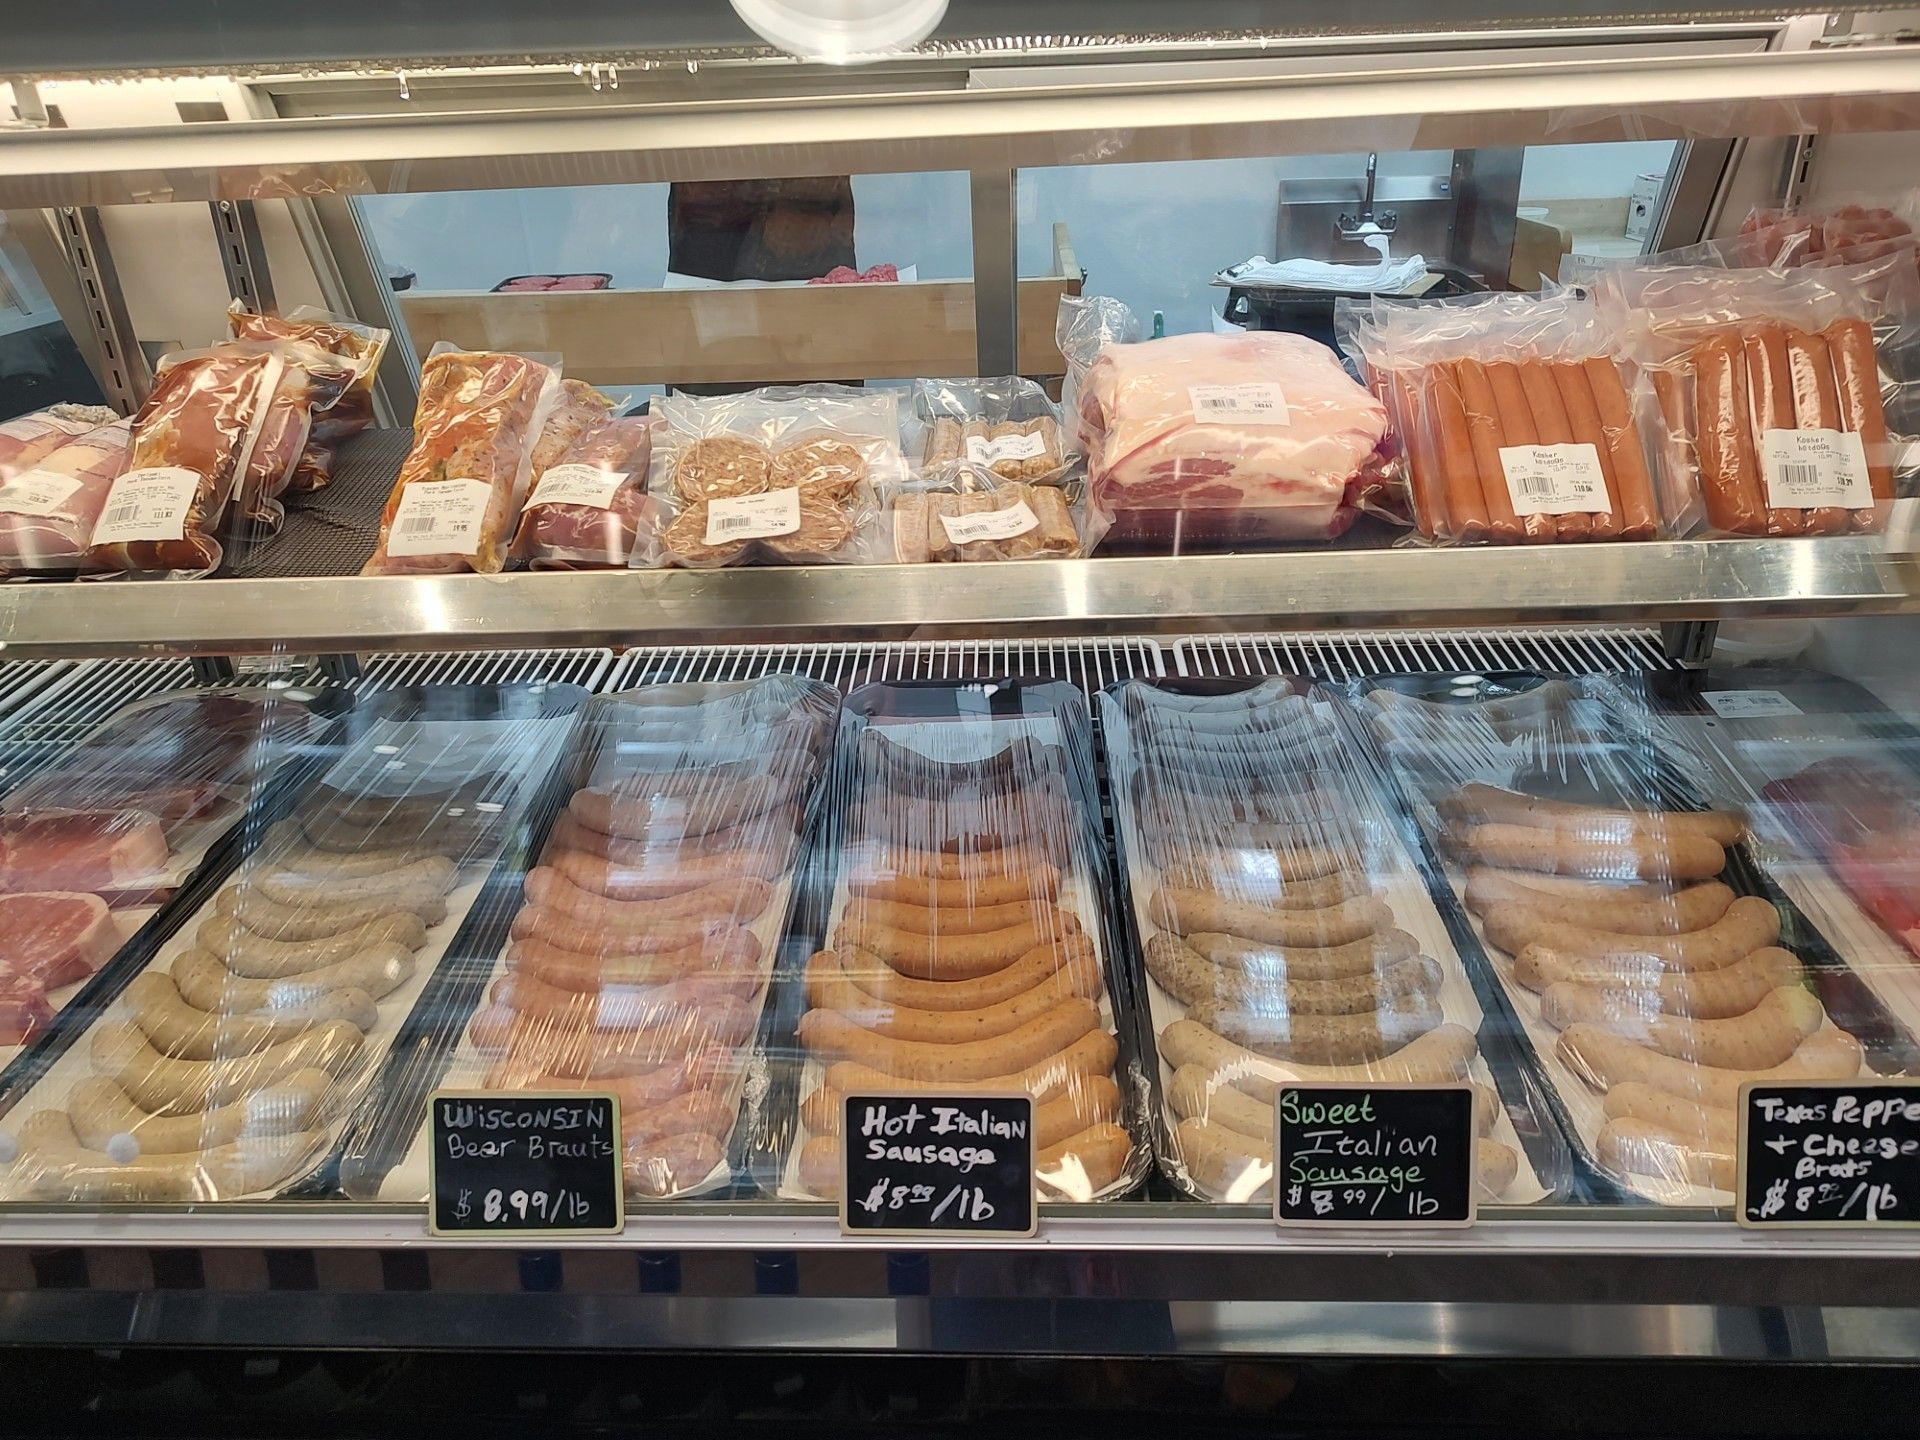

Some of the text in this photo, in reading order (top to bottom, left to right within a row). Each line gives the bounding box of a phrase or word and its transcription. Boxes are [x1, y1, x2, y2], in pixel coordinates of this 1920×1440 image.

[861, 1103, 926, 1137] Hot
[1281, 1090, 1377, 1125] Sweet
[1754, 1097, 1827, 1125] Texas
[529, 1133, 615, 1160] Brauts
[865, 1138, 997, 1174] Sausage
[1293, 1129, 1438, 1157] Italian
[1802, 1133, 1920, 1160] Cheese
[1289, 1156, 1426, 1194] Sausage
[1794, 1156, 1872, 1180] Brats
